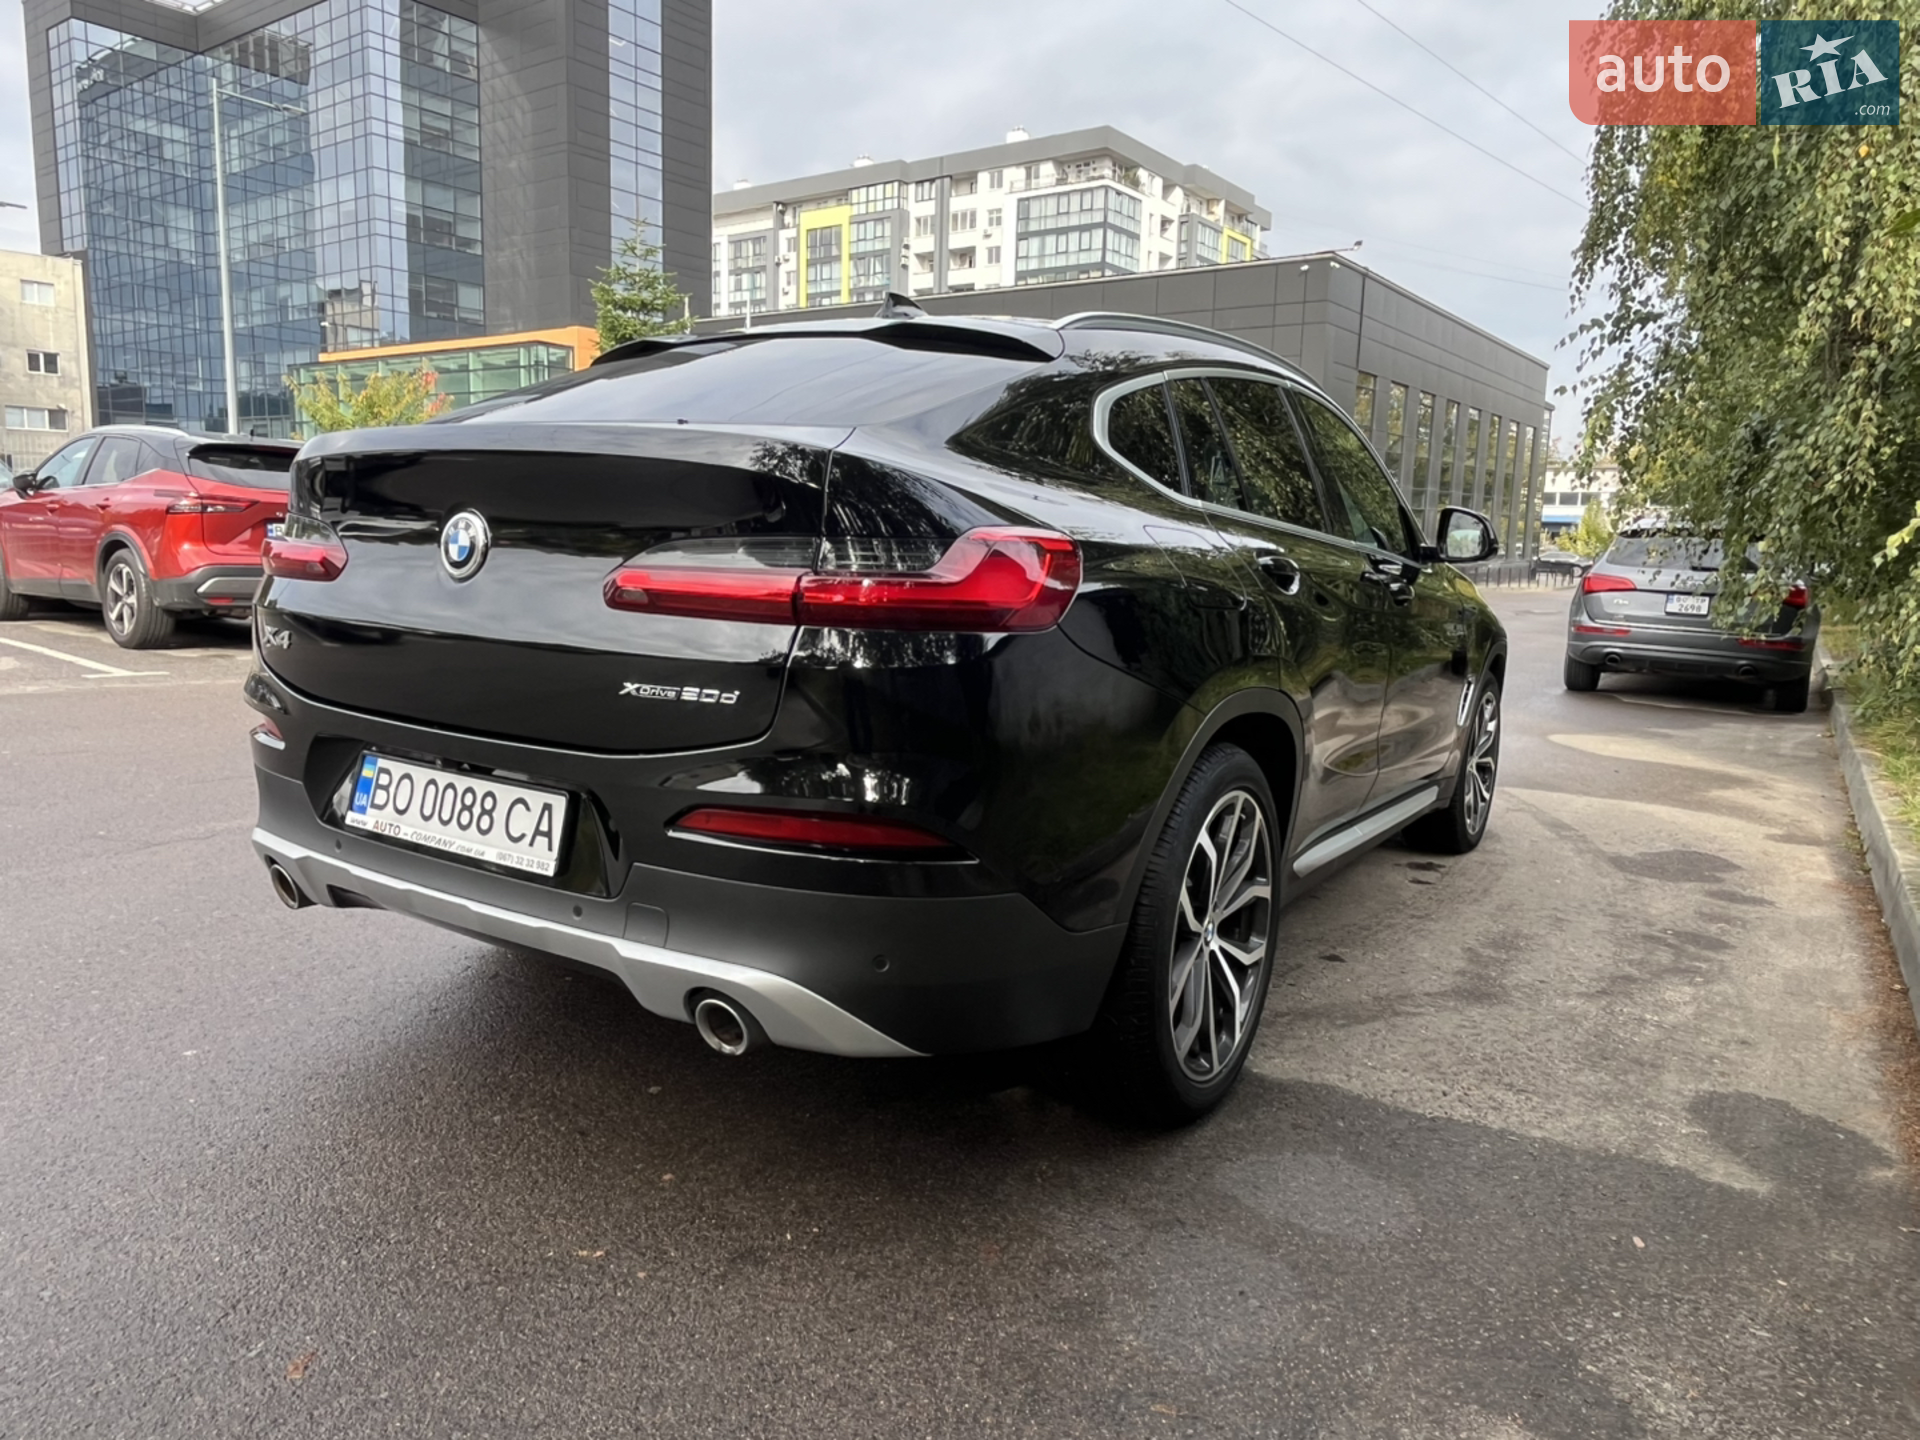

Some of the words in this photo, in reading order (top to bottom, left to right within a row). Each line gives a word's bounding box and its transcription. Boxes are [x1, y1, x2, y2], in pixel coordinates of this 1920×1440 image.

[262, 625, 290, 649] X4
[354, 792, 368, 806] UA
[369, 766, 415, 816] BO
[419, 778, 498, 836] 0088
[504, 796, 553, 852] CA
[372, 819, 401, 836] AUTO
[410, 831, 456, 849] COMPANY
